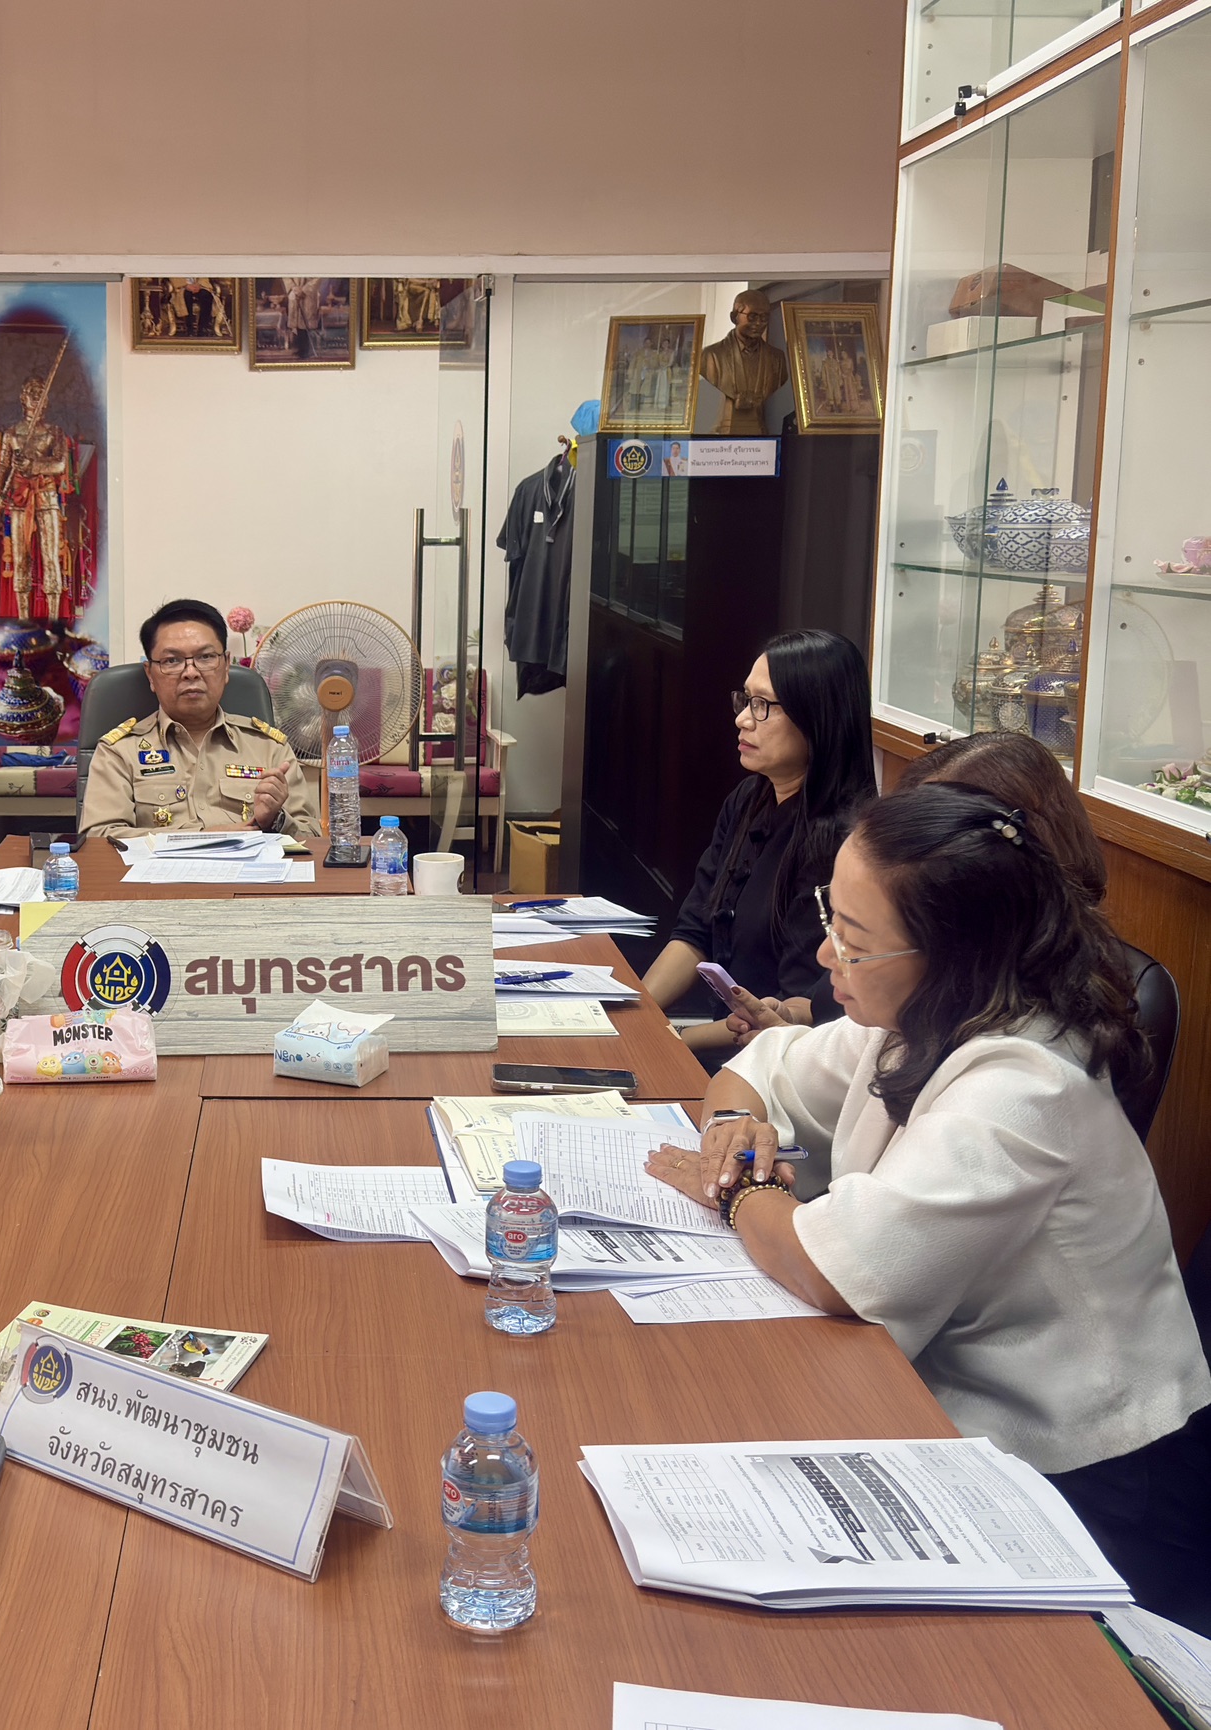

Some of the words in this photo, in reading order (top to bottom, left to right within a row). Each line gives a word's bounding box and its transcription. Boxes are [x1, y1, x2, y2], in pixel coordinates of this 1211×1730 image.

[184, 953, 466, 1014] สมุทรสาคร
[53, 1023, 113, 1046] MONSTER
[507, 1232, 524, 1241] aro
[74, 1377, 260, 1465] สนง.พัฒนาชุมชน
[47, 1425, 244, 1527] จังหวัดสมุทรสาคร
